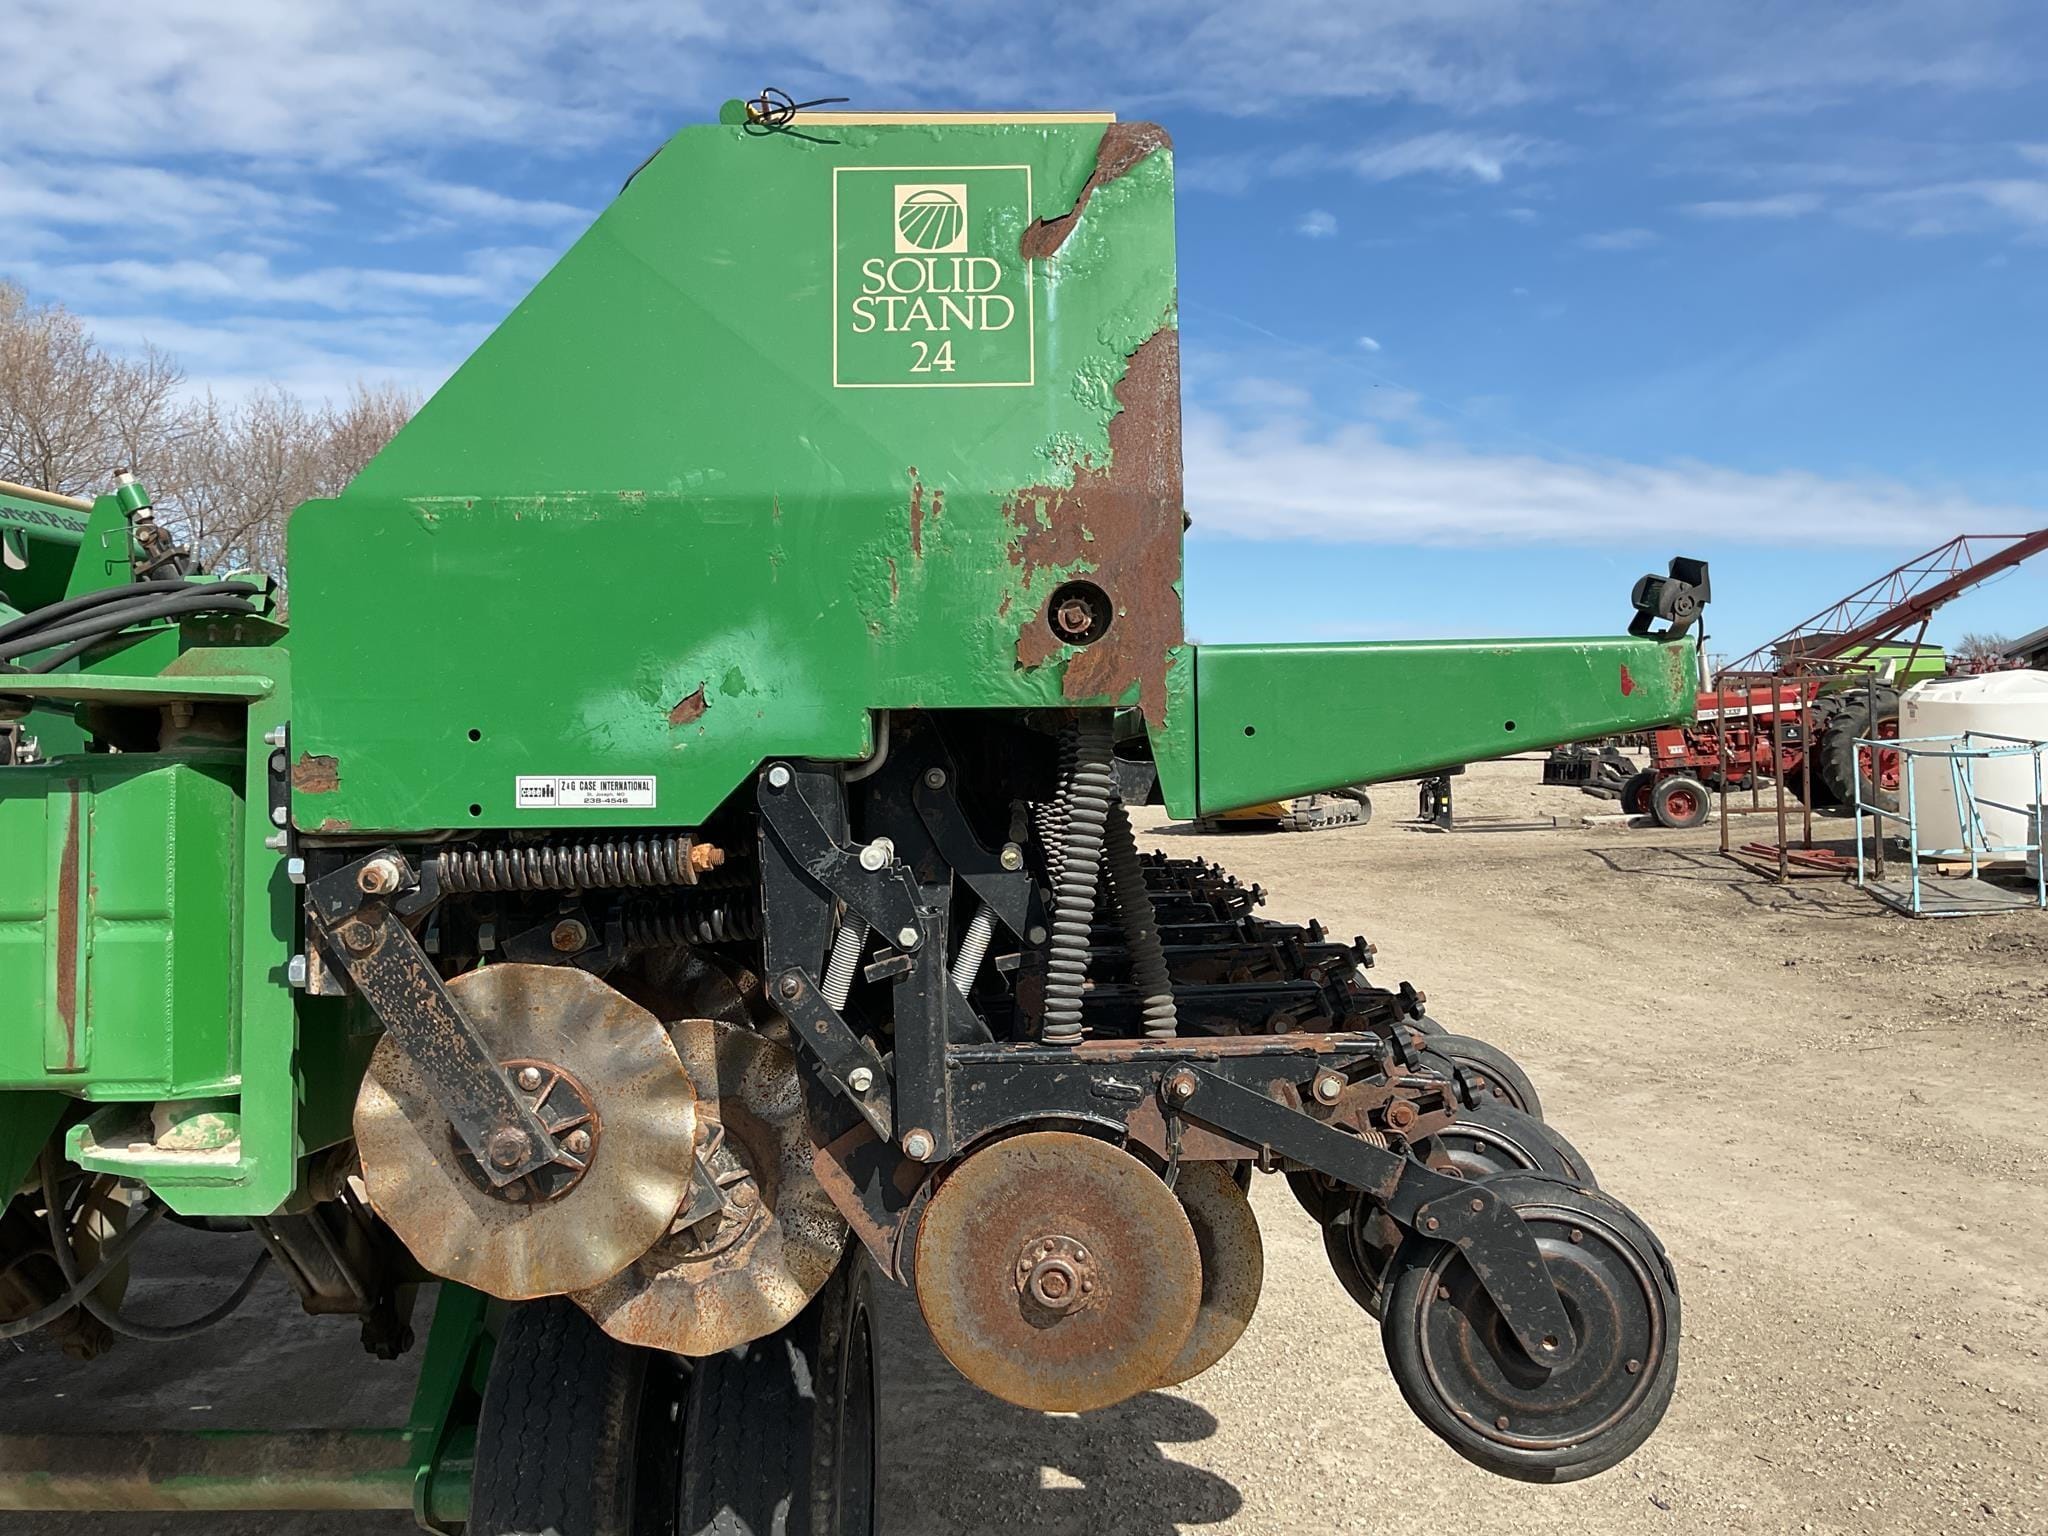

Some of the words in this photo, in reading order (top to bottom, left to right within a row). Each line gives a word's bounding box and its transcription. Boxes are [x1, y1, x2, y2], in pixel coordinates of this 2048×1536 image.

[862, 257, 1002, 295] SOLID
[852, 295, 1015, 333] STAND
[909, 340, 956, 372] 24
[579, 781, 597, 791] CASE
[600, 781, 650, 791] INTERNATIONAL
